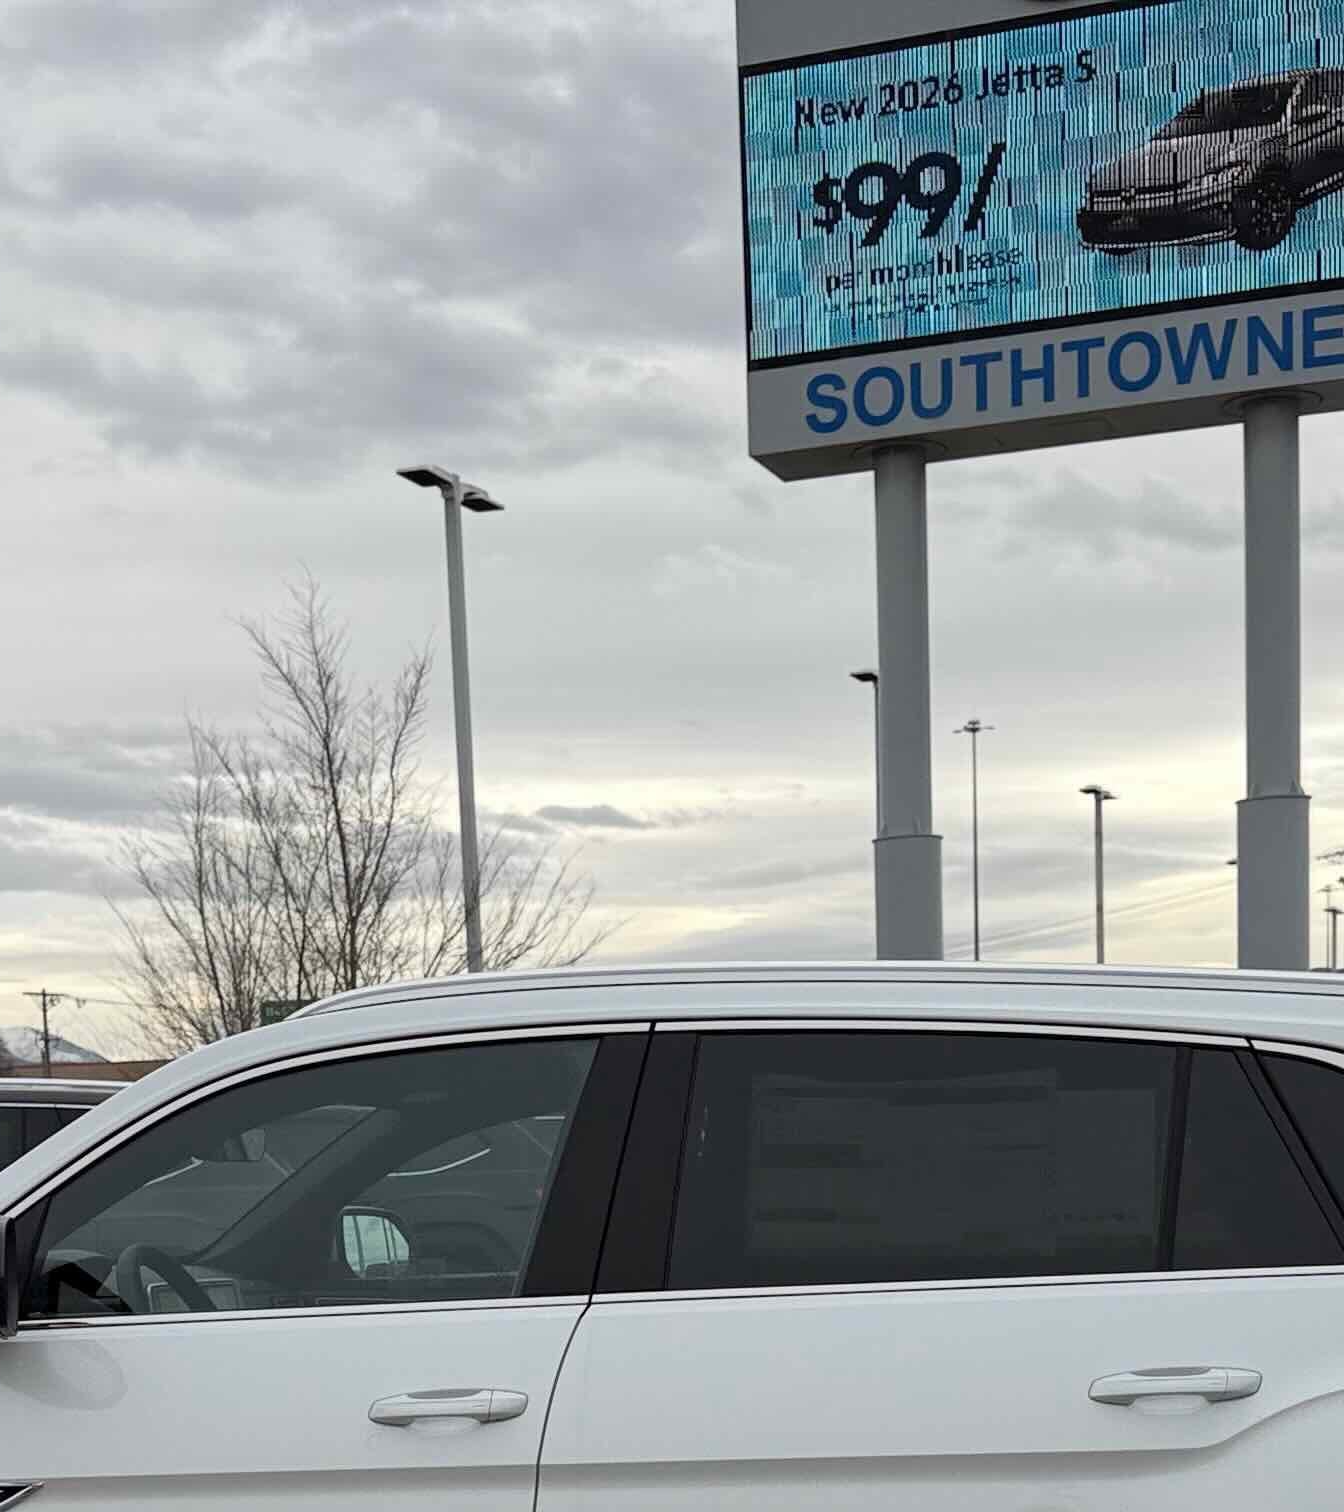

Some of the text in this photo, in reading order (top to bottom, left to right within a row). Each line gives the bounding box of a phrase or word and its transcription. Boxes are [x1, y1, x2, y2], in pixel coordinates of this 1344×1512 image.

[795, 48, 1096, 129] New 2026 Jetta S
[812, 141, 1006, 249] $99/
